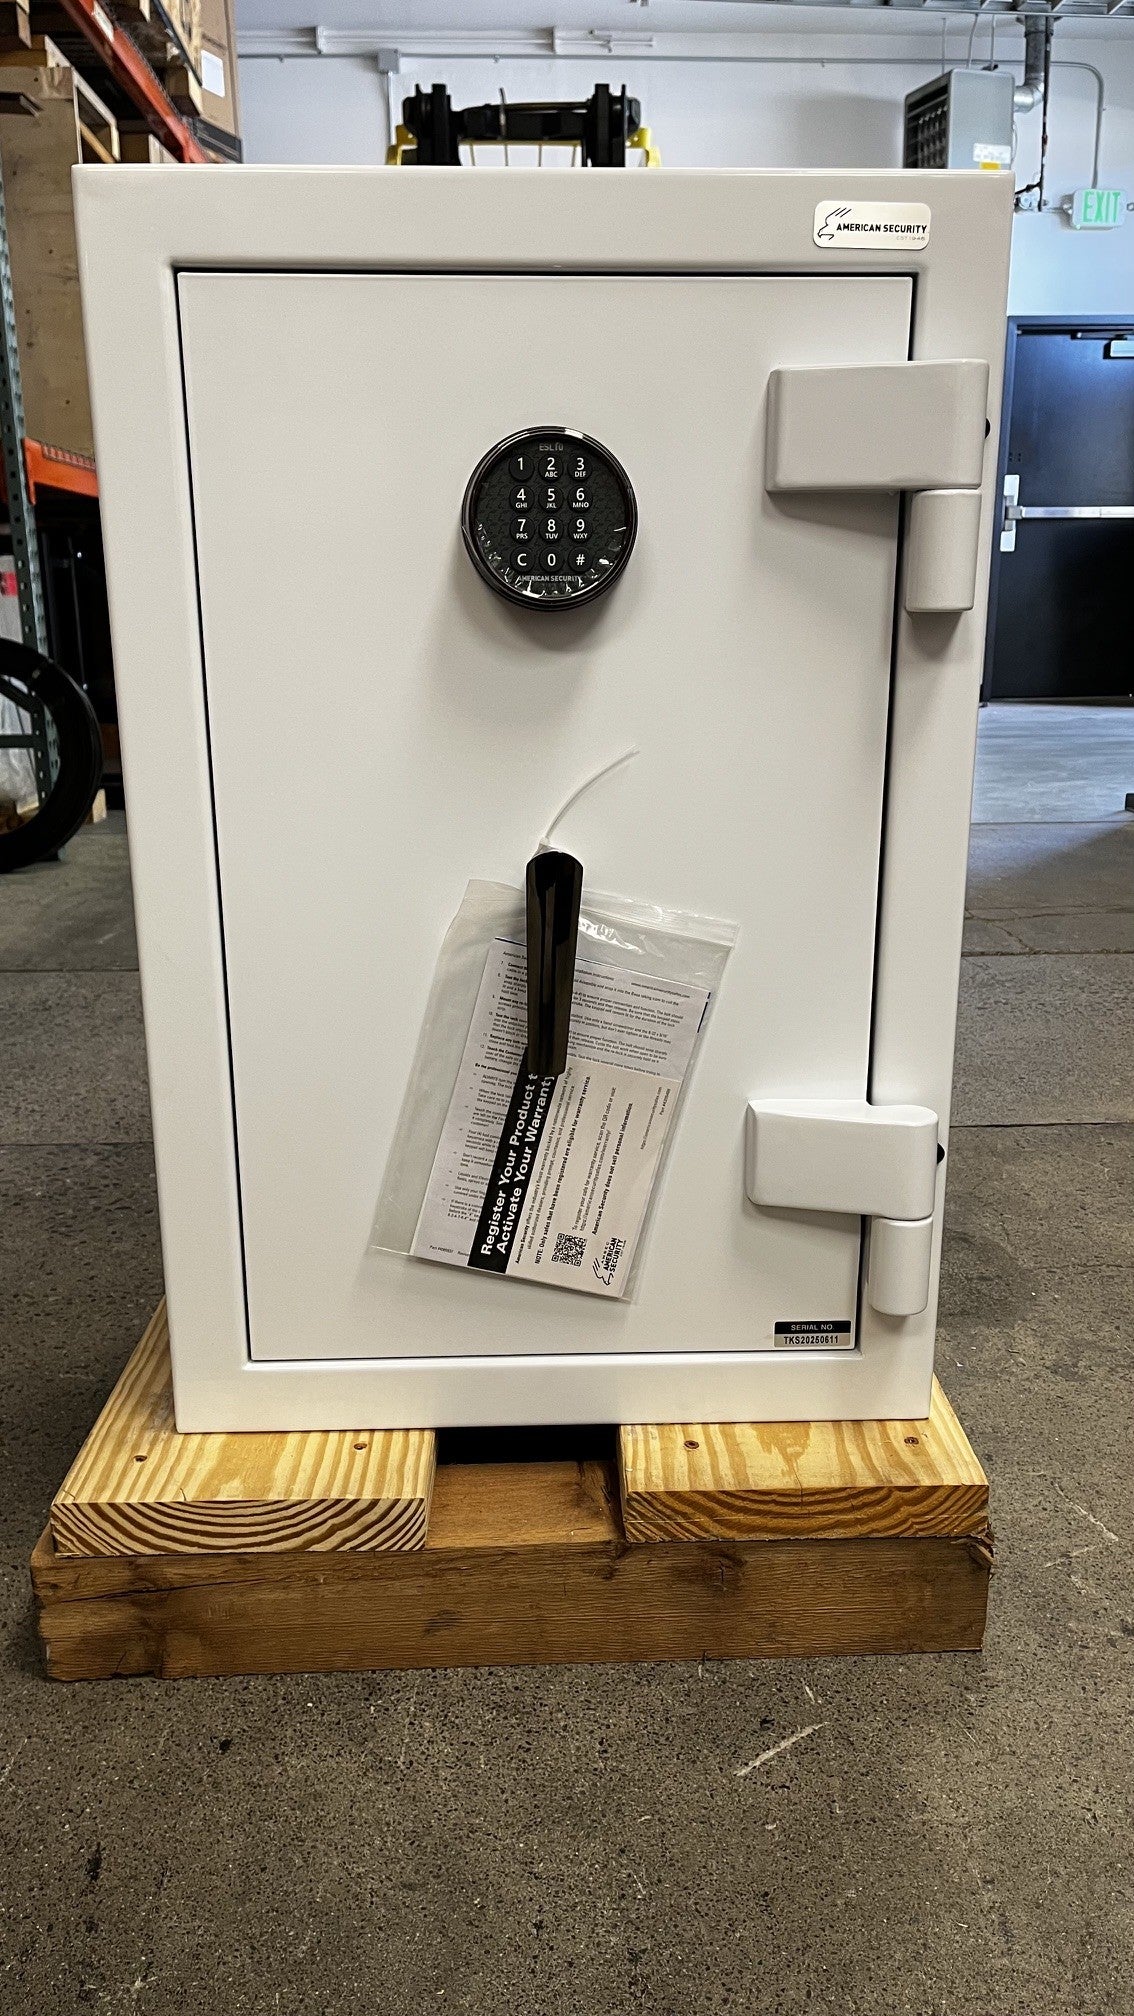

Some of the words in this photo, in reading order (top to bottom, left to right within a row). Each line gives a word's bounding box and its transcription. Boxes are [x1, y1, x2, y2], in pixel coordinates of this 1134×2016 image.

[1082, 191, 1121, 223] EXIT
[836, 223, 881, 232] AMERICAN
[883, 224, 927, 234] SECURITY
[517, 457, 524, 470] 1
[547, 457, 555, 470] 2
[576, 457, 584, 470] 3
[516, 488, 526, 501] 4
[547, 488, 555, 501] 5
[576, 488, 585, 501] 6
[517, 519, 526, 531] 7
[547, 519, 556, 532] 8
[576, 519, 585, 531] 9
[517, 554, 527, 566] C
[576, 554, 585, 566] #
[573, 1095, 585, 1118] warranty
[480, 1189, 509, 1256] Register
[498, 1148, 517, 1187] Your
[508, 1082, 535, 1146] Product
[527, 1071, 538, 1081] t
[556, 1156, 568, 1183] registered
[591, 1209, 603, 1235] American
[598, 1187, 609, 1209] Security
[604, 1174, 612, 1188] does
[613, 1132, 624, 1155] personal
[495, 1186, 522, 1254] Activate
[513, 1145, 533, 1183] Your
[549, 1197, 557, 1208] have
[545, 1207, 554, 1221] that
[514, 1242, 524, 1263] American
[520, 1224, 529, 1242] Security
[538, 1235, 547, 1247] Only
[534, 1247, 543, 1264] NOTE:
[602, 1236, 617, 1271] AMERICAN
[609, 1238, 623, 1272] SECURITY
[784, 1335, 838, 1344] TKS20250611
